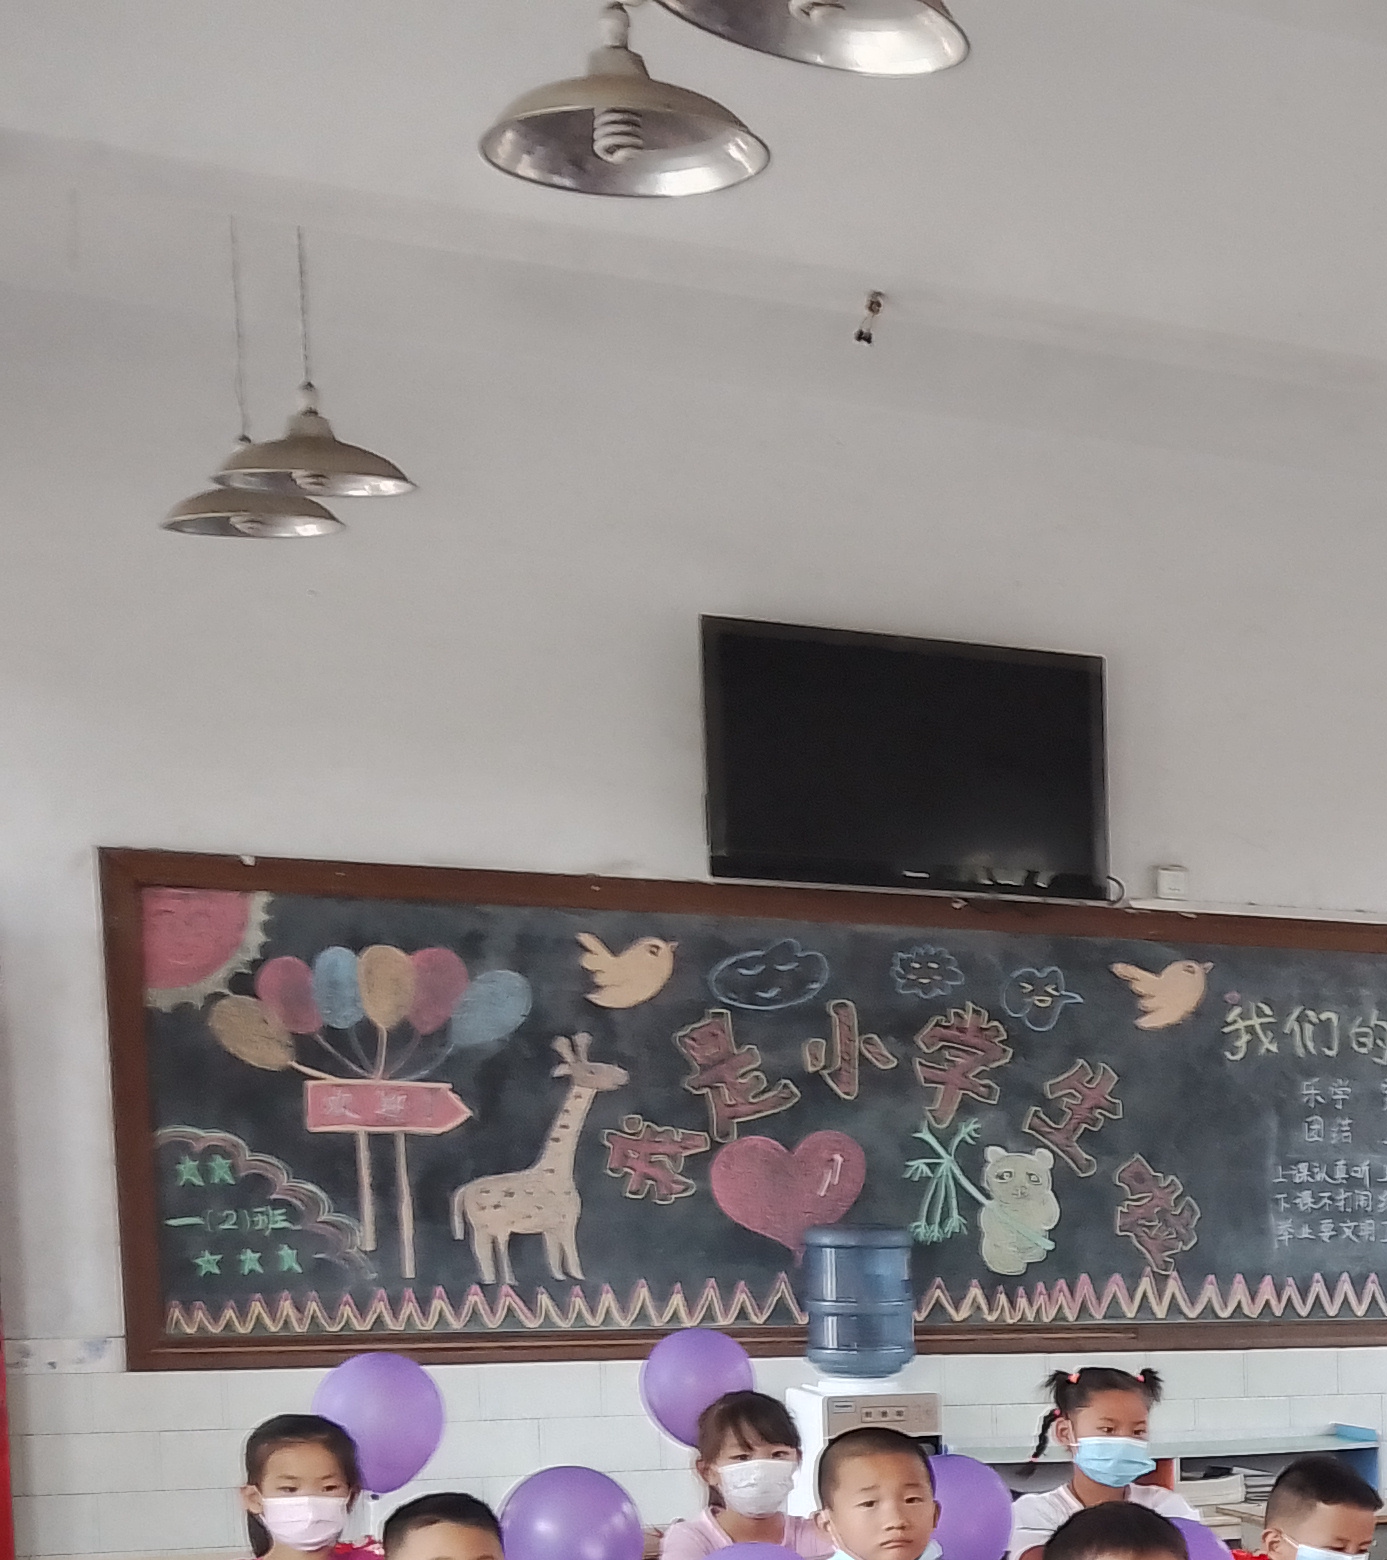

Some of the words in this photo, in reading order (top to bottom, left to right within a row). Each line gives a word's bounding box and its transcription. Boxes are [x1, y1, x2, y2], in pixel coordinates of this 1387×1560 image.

[1302, 1077, 1352, 1110] 乐学
[1304, 1115, 1353, 1143] 团结
[1272, 1159, 1371, 1188] 上课认真听
